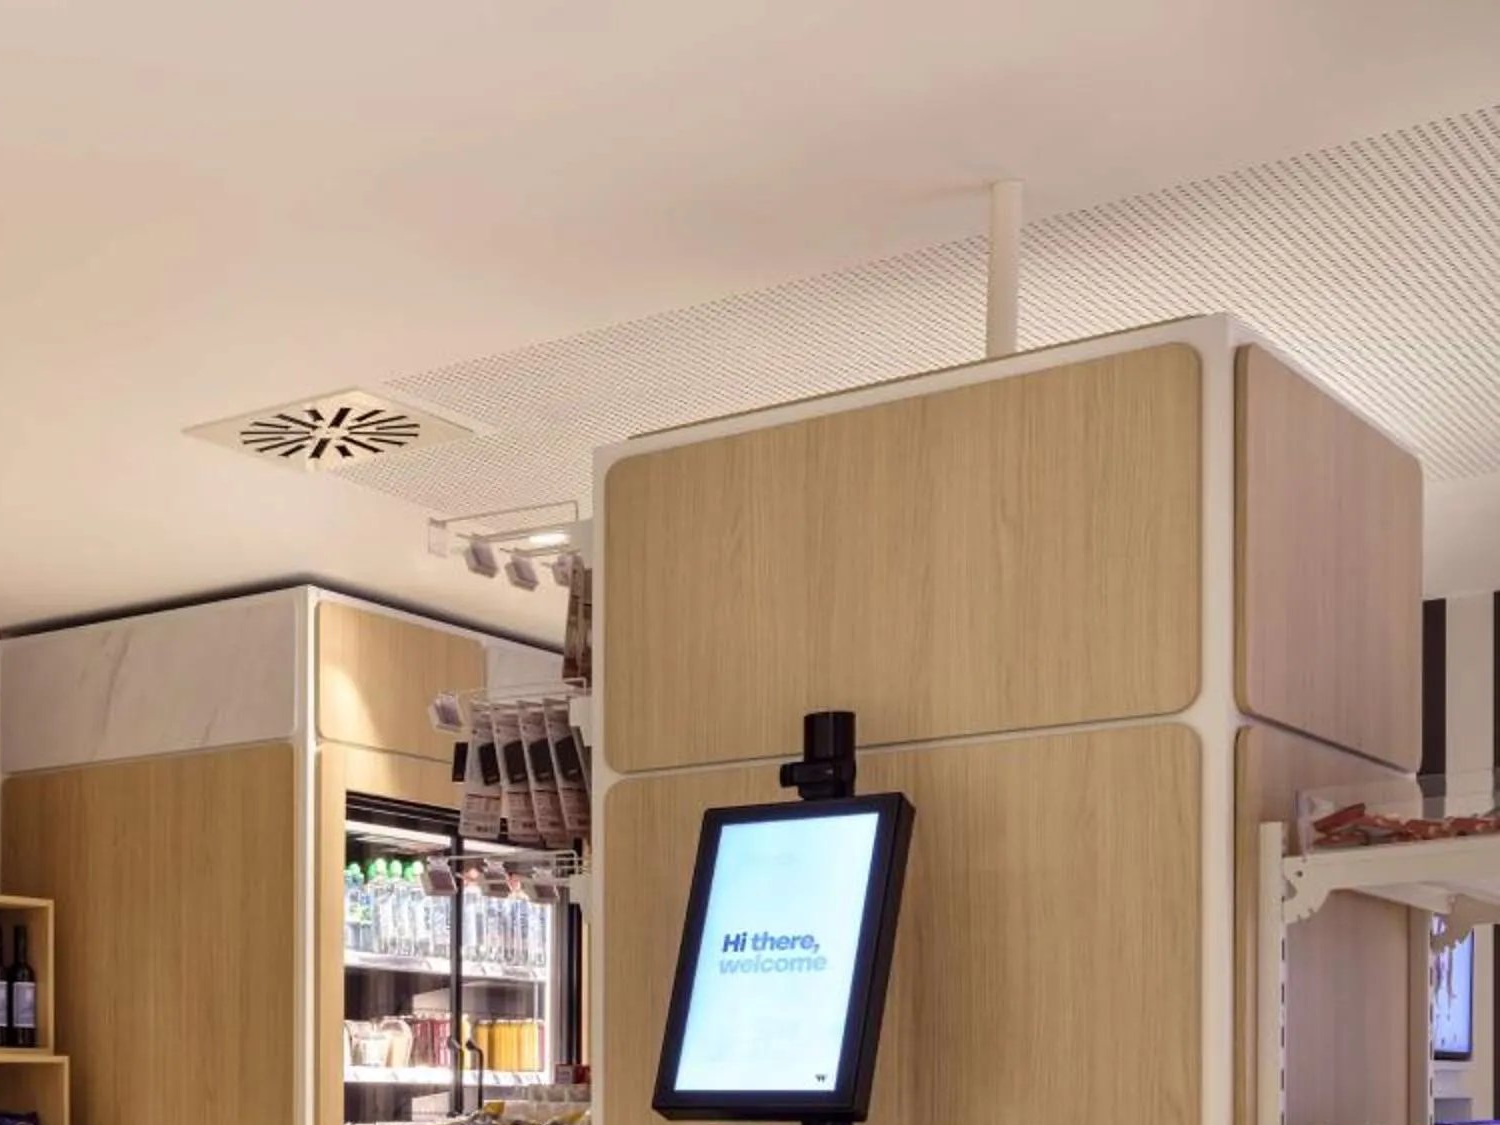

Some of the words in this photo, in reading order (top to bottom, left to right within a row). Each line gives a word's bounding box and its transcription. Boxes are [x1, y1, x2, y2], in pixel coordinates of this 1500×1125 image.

[722, 932, 748, 953] Hi
[751, 931, 821, 954] there,
[719, 954, 828, 975] welcome
